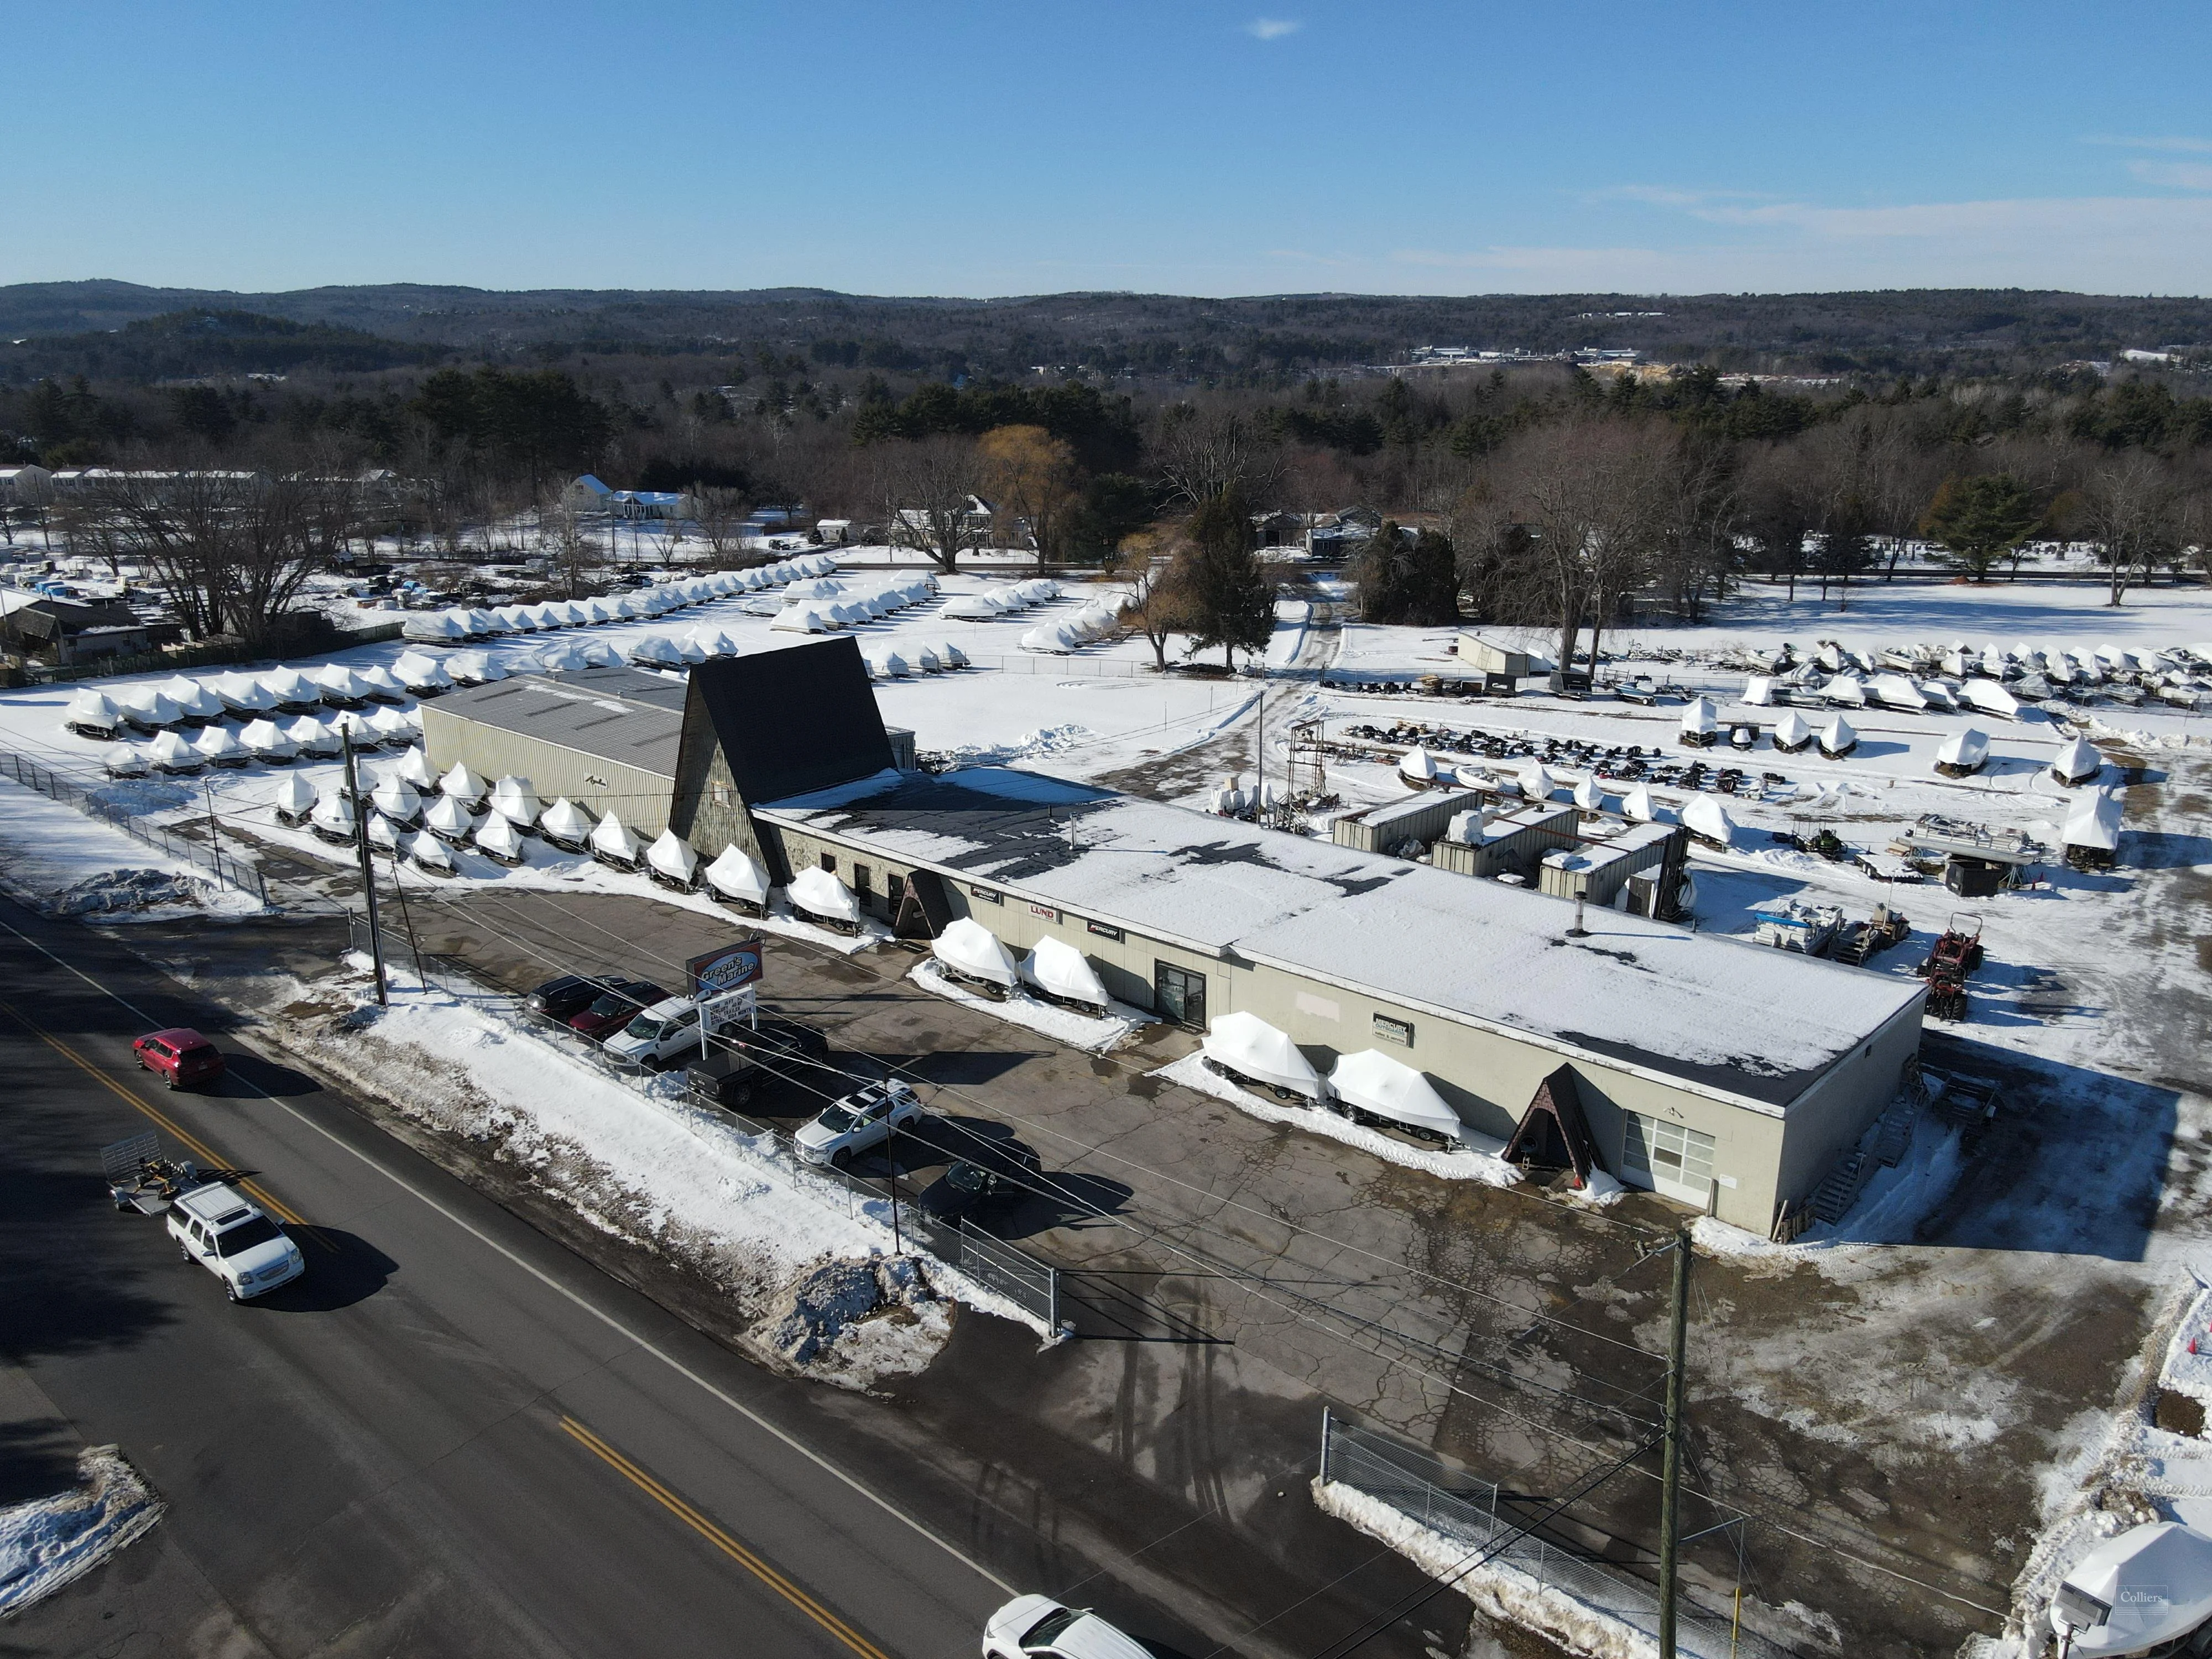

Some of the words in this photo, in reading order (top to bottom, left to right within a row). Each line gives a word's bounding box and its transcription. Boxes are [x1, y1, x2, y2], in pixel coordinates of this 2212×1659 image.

[973, 888, 996, 898] MERCURY
[1031, 905, 1053, 918] LUND
[1090, 924, 1118, 936] MERCURY
[701, 957, 742, 982] Green's
[718, 962, 755, 985] Marine
[1375, 1018, 1407, 1032] MERCURY
